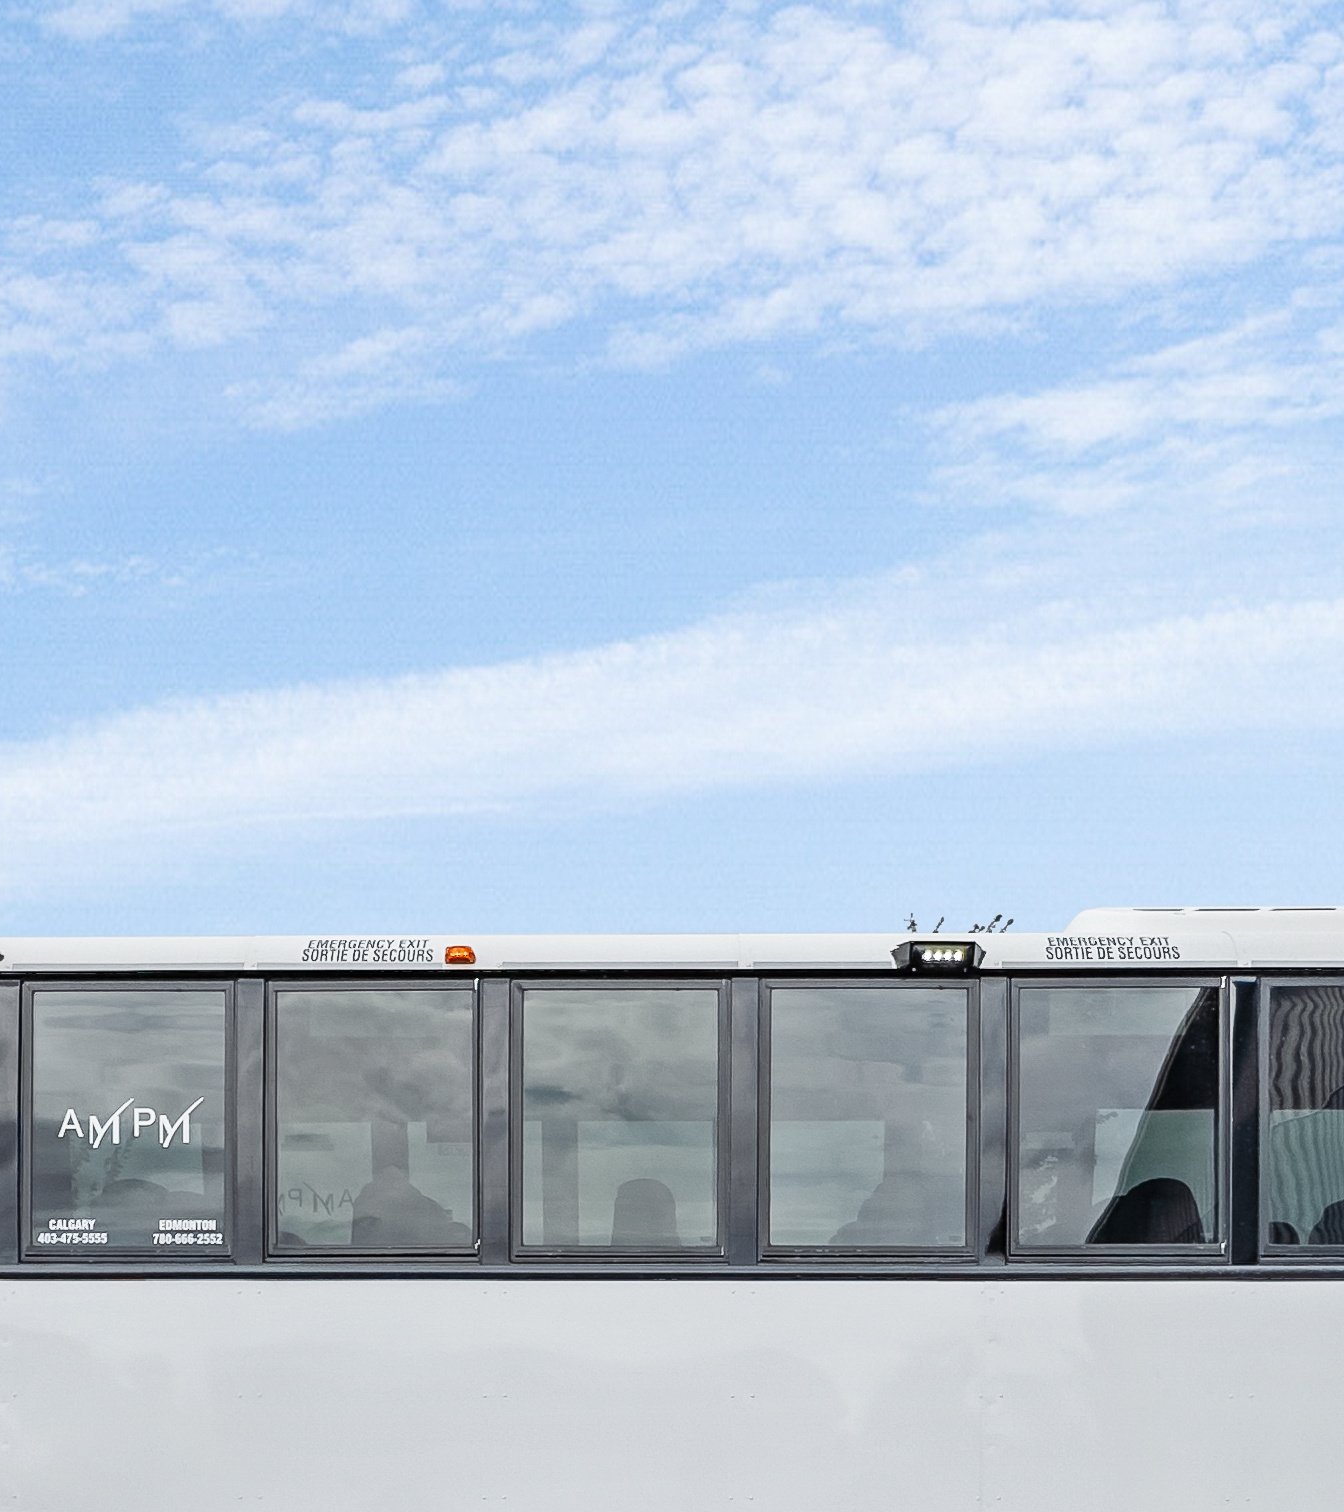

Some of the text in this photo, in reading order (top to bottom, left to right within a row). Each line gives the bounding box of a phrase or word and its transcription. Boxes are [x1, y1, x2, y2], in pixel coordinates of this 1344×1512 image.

[308, 939, 430, 949] EMERGENCY EXIT
[1047, 937, 1170, 947] EMERGENCY EXIT
[301, 949, 434, 962] SORTIE DE SECOURS
[1045, 946, 1181, 960] SORTIE DE SECOURS
[48, 1219, 97, 1231] CALGARY
[159, 1219, 217, 1231] EDMONTON
[37, 1232, 108, 1245] 403-475-5555
